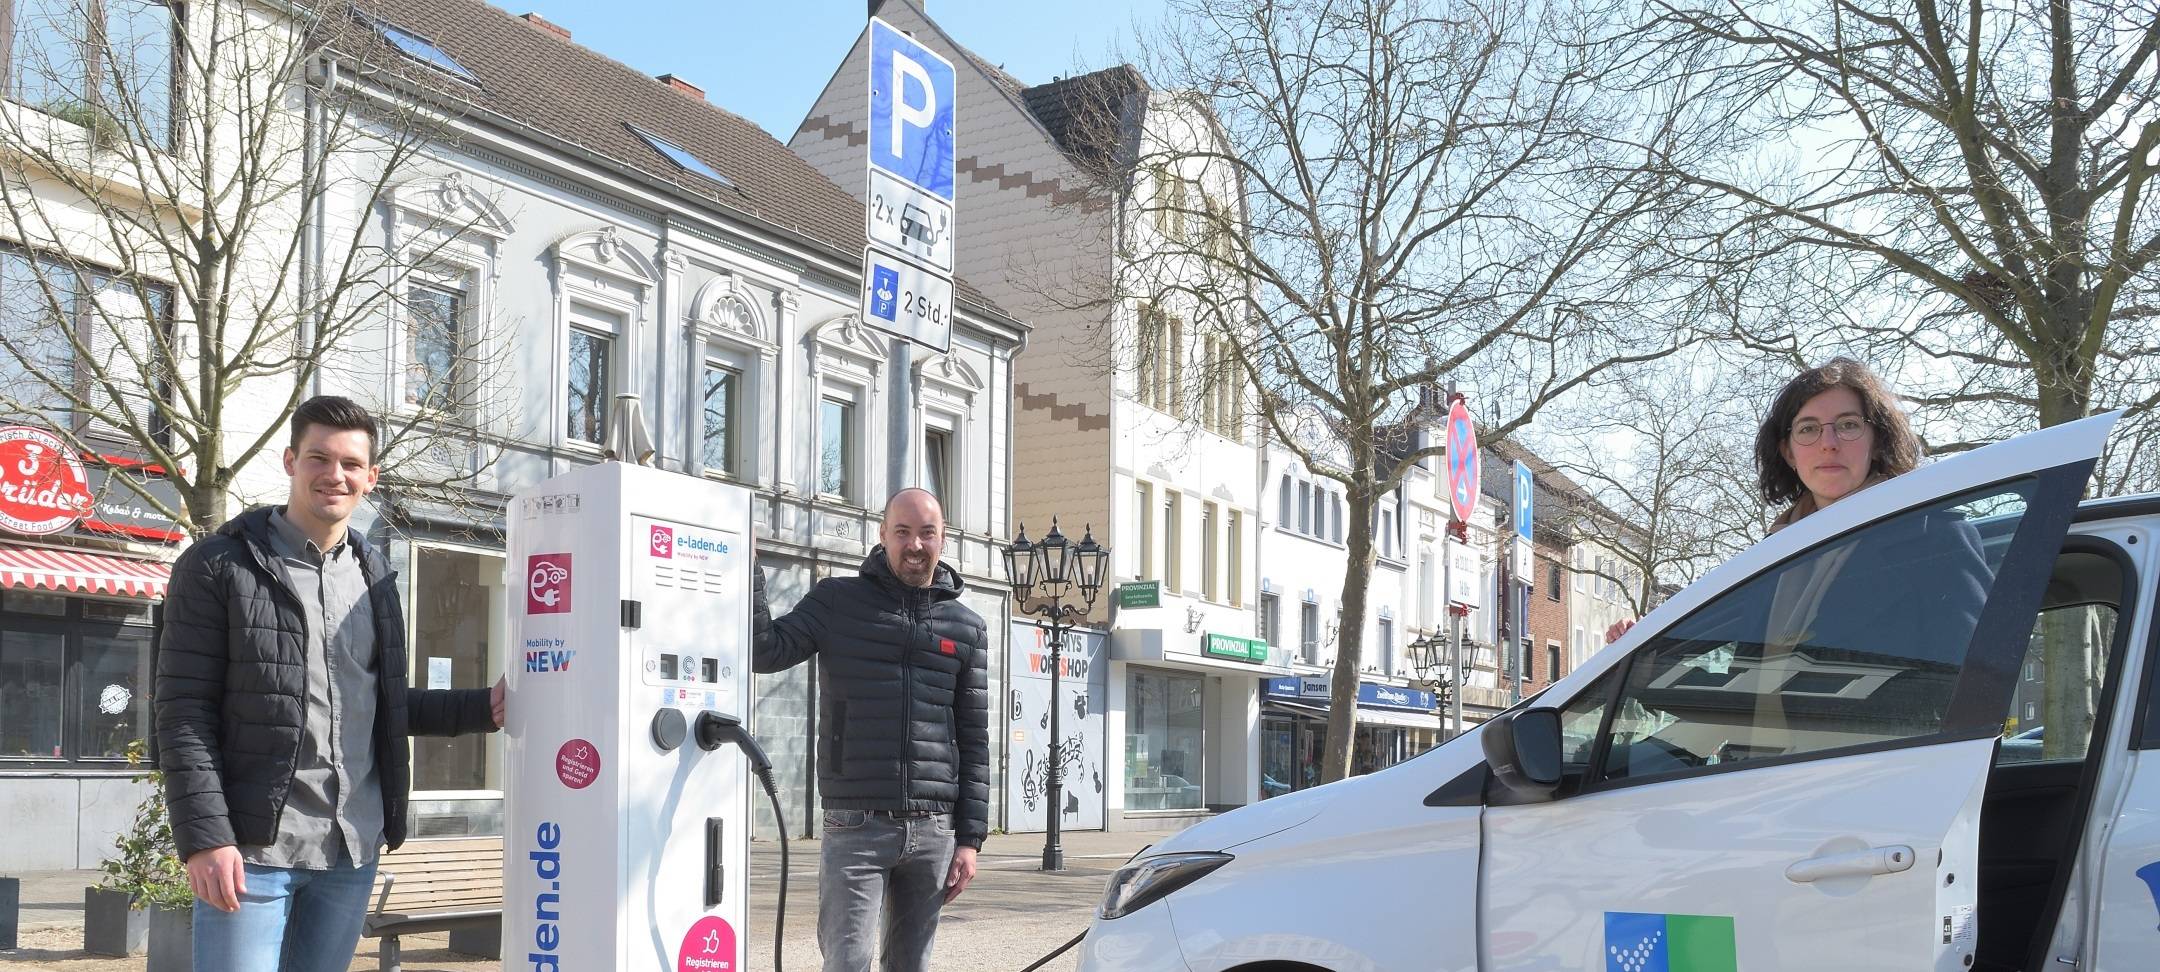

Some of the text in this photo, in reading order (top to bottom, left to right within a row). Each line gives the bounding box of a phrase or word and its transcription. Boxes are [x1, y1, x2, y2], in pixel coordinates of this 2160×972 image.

[891, 49, 936, 160] P
[875, 193, 883, 220] 2
[904, 290, 944, 326] 2 Std.
[18, 443, 43, 476] 3
[0, 466, 88, 511] rüder
[101, 503, 131, 516] Kebab
[1520, 473, 1530, 528] P
[31, 521, 54, 532] Food
[677, 535, 728, 554] e-laden.de
[1121, 583, 1156, 592] PROVINZIAL
[526, 637, 565, 649] Mobility by
[1035, 628, 1082, 653] TOMYS
[1211, 636, 1249, 654] PROVINZIAL
[526, 650, 572, 673] NEW
[1029, 653, 1088, 679] WORSHOP
[1303, 681, 1328, 694] Jansen
[561, 754, 594, 774] Registrieren
[562, 764, 589, 779] und Geld
[562, 772, 583, 785] sparen!
[685, 956, 729, 970] Registrieren
